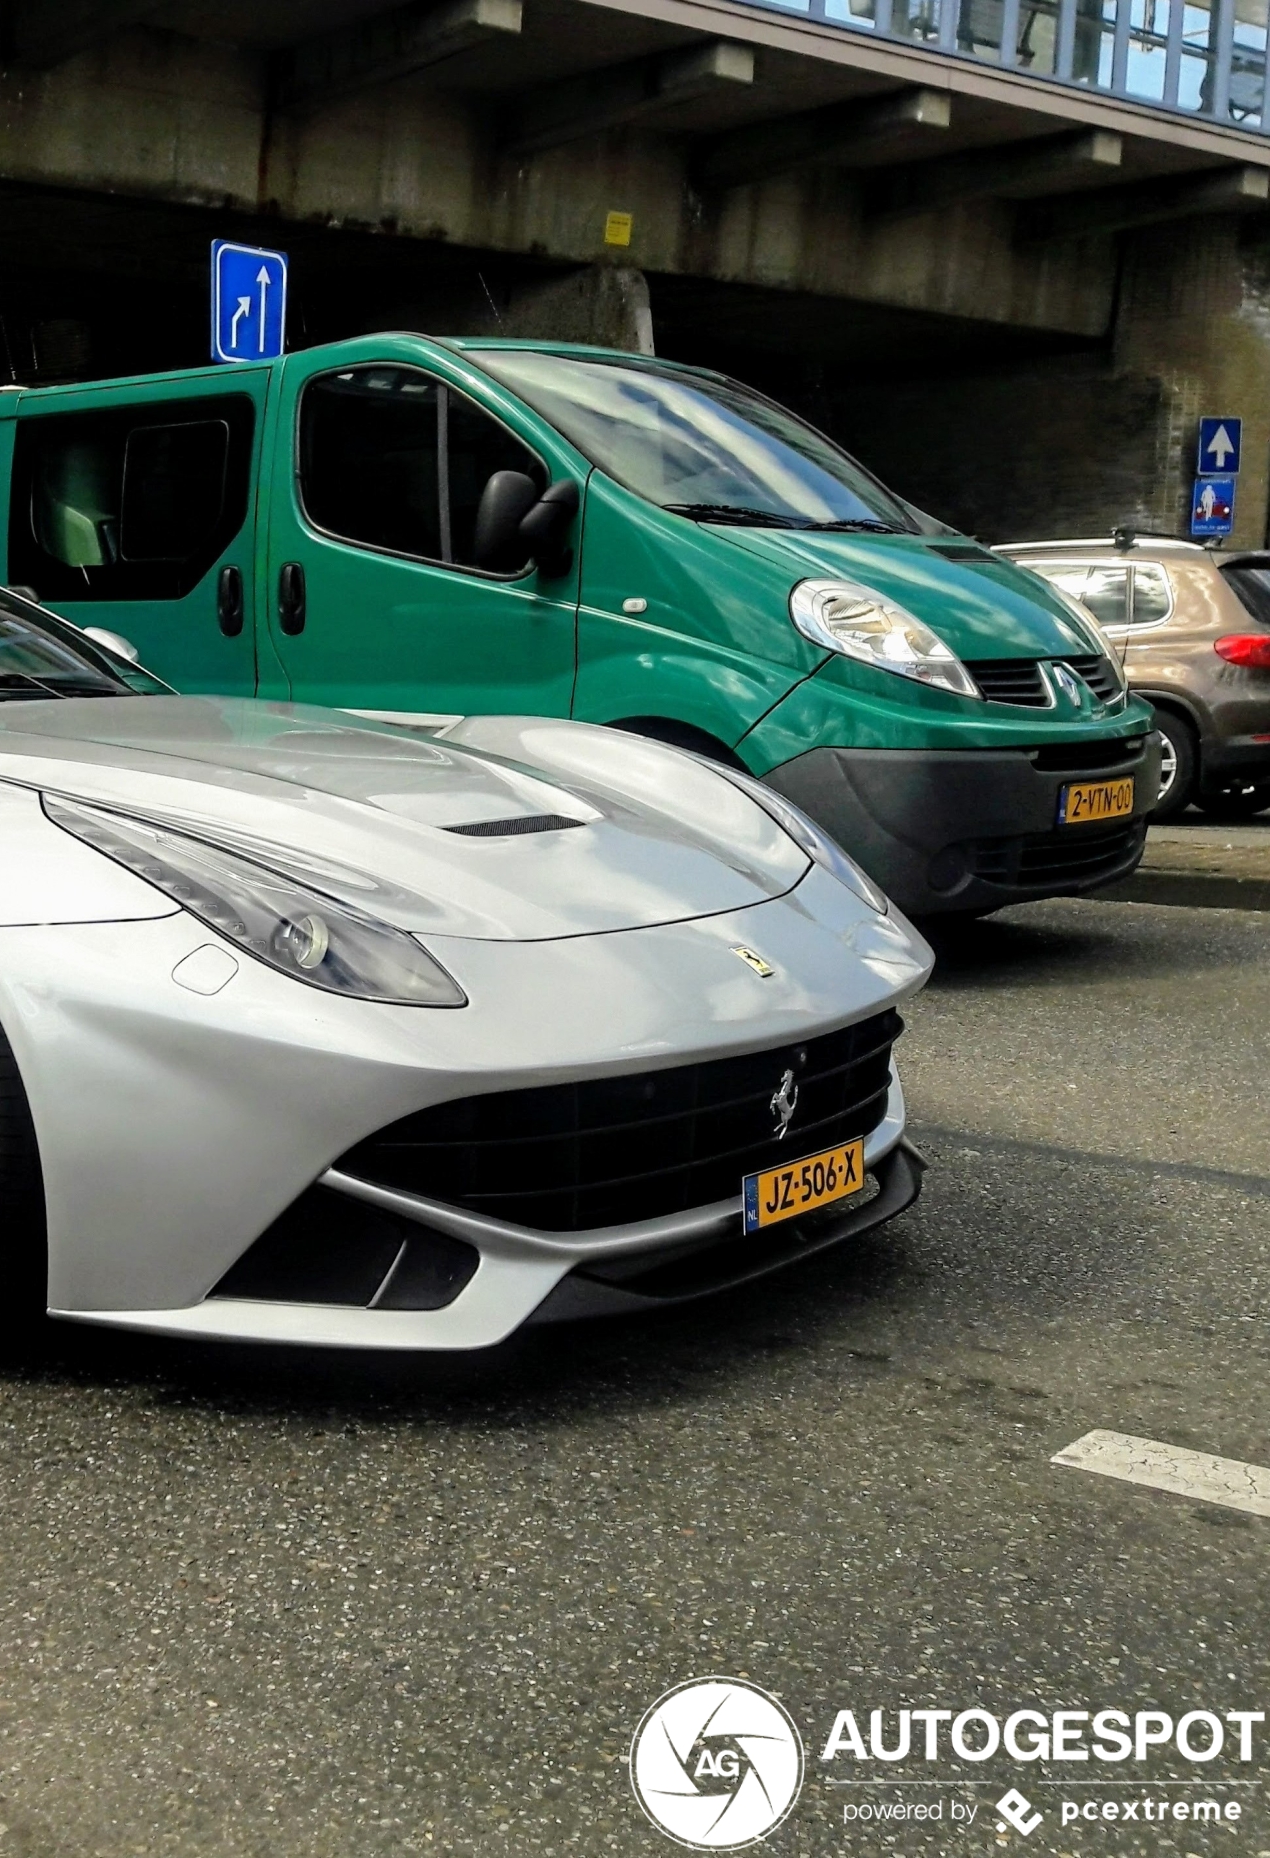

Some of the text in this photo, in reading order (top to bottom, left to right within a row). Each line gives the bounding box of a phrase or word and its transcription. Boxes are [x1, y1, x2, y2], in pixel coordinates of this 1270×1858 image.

[1072, 784, 1131, 817] 2-VTN-00
[766, 1148, 857, 1214] JZ-506-X
[747, 1210, 758, 1222] NL
